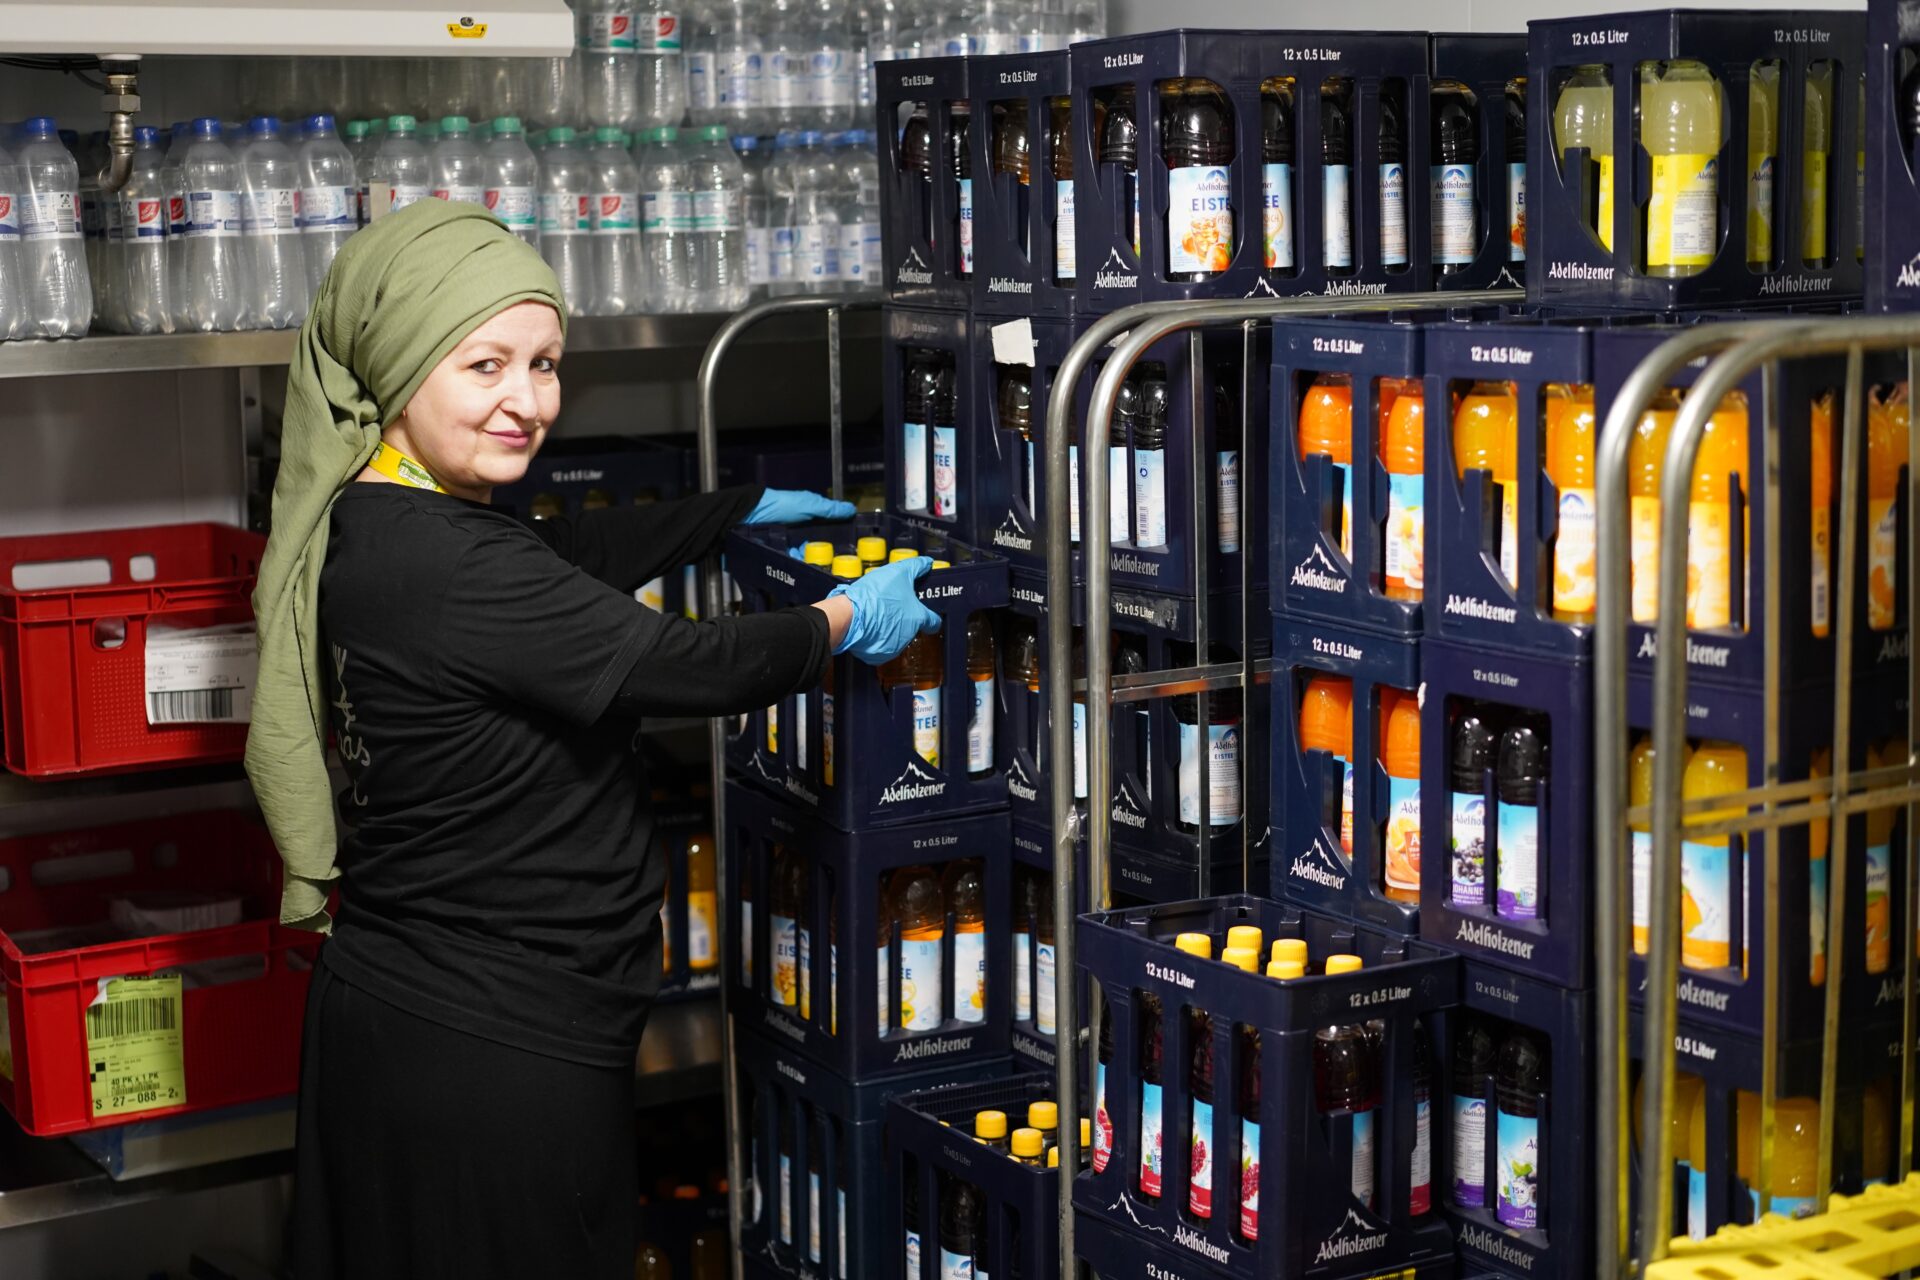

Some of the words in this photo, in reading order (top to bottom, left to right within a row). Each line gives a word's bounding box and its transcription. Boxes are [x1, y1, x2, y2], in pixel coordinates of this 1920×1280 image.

[1571, 32, 1582, 46] 12
[1582, 35, 1589, 45] x
[1590, 31, 1606, 45] 0.5
[1607, 28, 1629, 43] Liter
[1773, 30, 1784, 43] 12
[1784, 33, 1792, 43] x
[1793, 30, 1808, 43] 0.5
[1809, 28, 1831, 42] Liter
[1103, 56, 1112, 69] 12
[1112, 59, 1117, 67] x
[1117, 55, 1128, 67] 0.5
[1128, 53, 1144, 66] Liter
[1282, 48, 1294, 61] 12
[1296, 51, 1302, 61] x
[1304, 48, 1318, 61] 0.5
[1320, 47, 1342, 61] Liter
[901, 76, 908, 87] 12
[922, 74, 935, 85] Liter
[1000, 73, 1007, 84] 12
[1007, 75, 1012, 83] x
[1012, 72, 1022, 83] 0.5
[1022, 70, 1038, 81] Liter
[896, 267, 934, 285] Adelholzener
[1093, 271, 1139, 290] Adelholzener
[1548, 262, 1616, 281] Adelholzener
[987, 277, 1033, 294] Adelholzener
[1323, 279, 1387, 297] Adelholzener
[1757, 274, 1833, 297] Adelholzener
[1312, 337, 1323, 352] 12
[1323, 341, 1330, 351] x
[1330, 338, 1343, 353] 0.5
[1344, 338, 1364, 355] Liter
[1470, 345, 1482, 363] 12
[1482, 349, 1490, 363] x
[1490, 346, 1508, 364] 0.5
[1509, 346, 1534, 365] Liter
[992, 530, 1032, 551] Adelholzener
[765, 565, 771, 577] 12
[784, 573, 796, 587] Liter
[1290, 565, 1347, 593] Adelholzener
[926, 587, 941, 599] 0.5
[942, 584, 964, 598] Liter
[1011, 589, 1016, 599] 2
[1115, 602, 1123, 615] 12
[1123, 605, 1129, 616] x
[1129, 605, 1140, 618] 0.5
[1140, 607, 1155, 621] Liter
[1444, 594, 1518, 624] Adelholzener
[1312, 637, 1322, 652] 12
[1322, 641, 1330, 653] x
[1330, 640, 1343, 656] 0.5
[1343, 643, 1364, 661] Liter
[1636, 632, 1730, 668] Alzener
[1472, 669, 1482, 681] 12
[1482, 672, 1488, 682] x
[1488, 672, 1500, 685] 0.5
[1500, 673, 1519, 688] Liter
[878, 782, 947, 807] Adelholzener
[1008, 777, 1037, 802] lholzener
[1111, 804, 1147, 829] elholzener
[913, 839, 921, 849] 12
[921, 840, 928, 848] x
[928, 837, 941, 848] 0.5
[942, 836, 960, 847] Liter
[1121, 867, 1129, 878] 12
[1141, 872, 1153, 885] Liter
[1290, 857, 1346, 891] Adelholzener
[1455, 919, 1535, 960] Adelholzener
[1145, 961, 1156, 977] 12
[1156, 967, 1162, 978] x
[1162, 966, 1175, 982] 0.5
[1176, 969, 1196, 989] Liter
[1349, 992, 1361, 1008] 12
[1362, 995, 1370, 1006] x
[1371, 989, 1387, 1005] 0.5
[1388, 986, 1412, 1003] Liter
[1474, 981, 1484, 993] 12
[1484, 985, 1489, 994] x
[1489, 984, 1502, 997] 0.5
[1502, 988, 1520, 1005] Liter
[893, 1036, 974, 1063] Adelholzener
[1691, 1040, 1718, 1061] Liter
[122, 1075, 133, 1083] PK
[148, 1071, 159, 1079] PK
[1172, 1224, 1230, 1265] Adelholzener
[1313, 1232, 1388, 1265] Adelholzener
[1456, 1222, 1535, 1271] Adelholzener
[1146, 1262, 1156, 1277] 12
